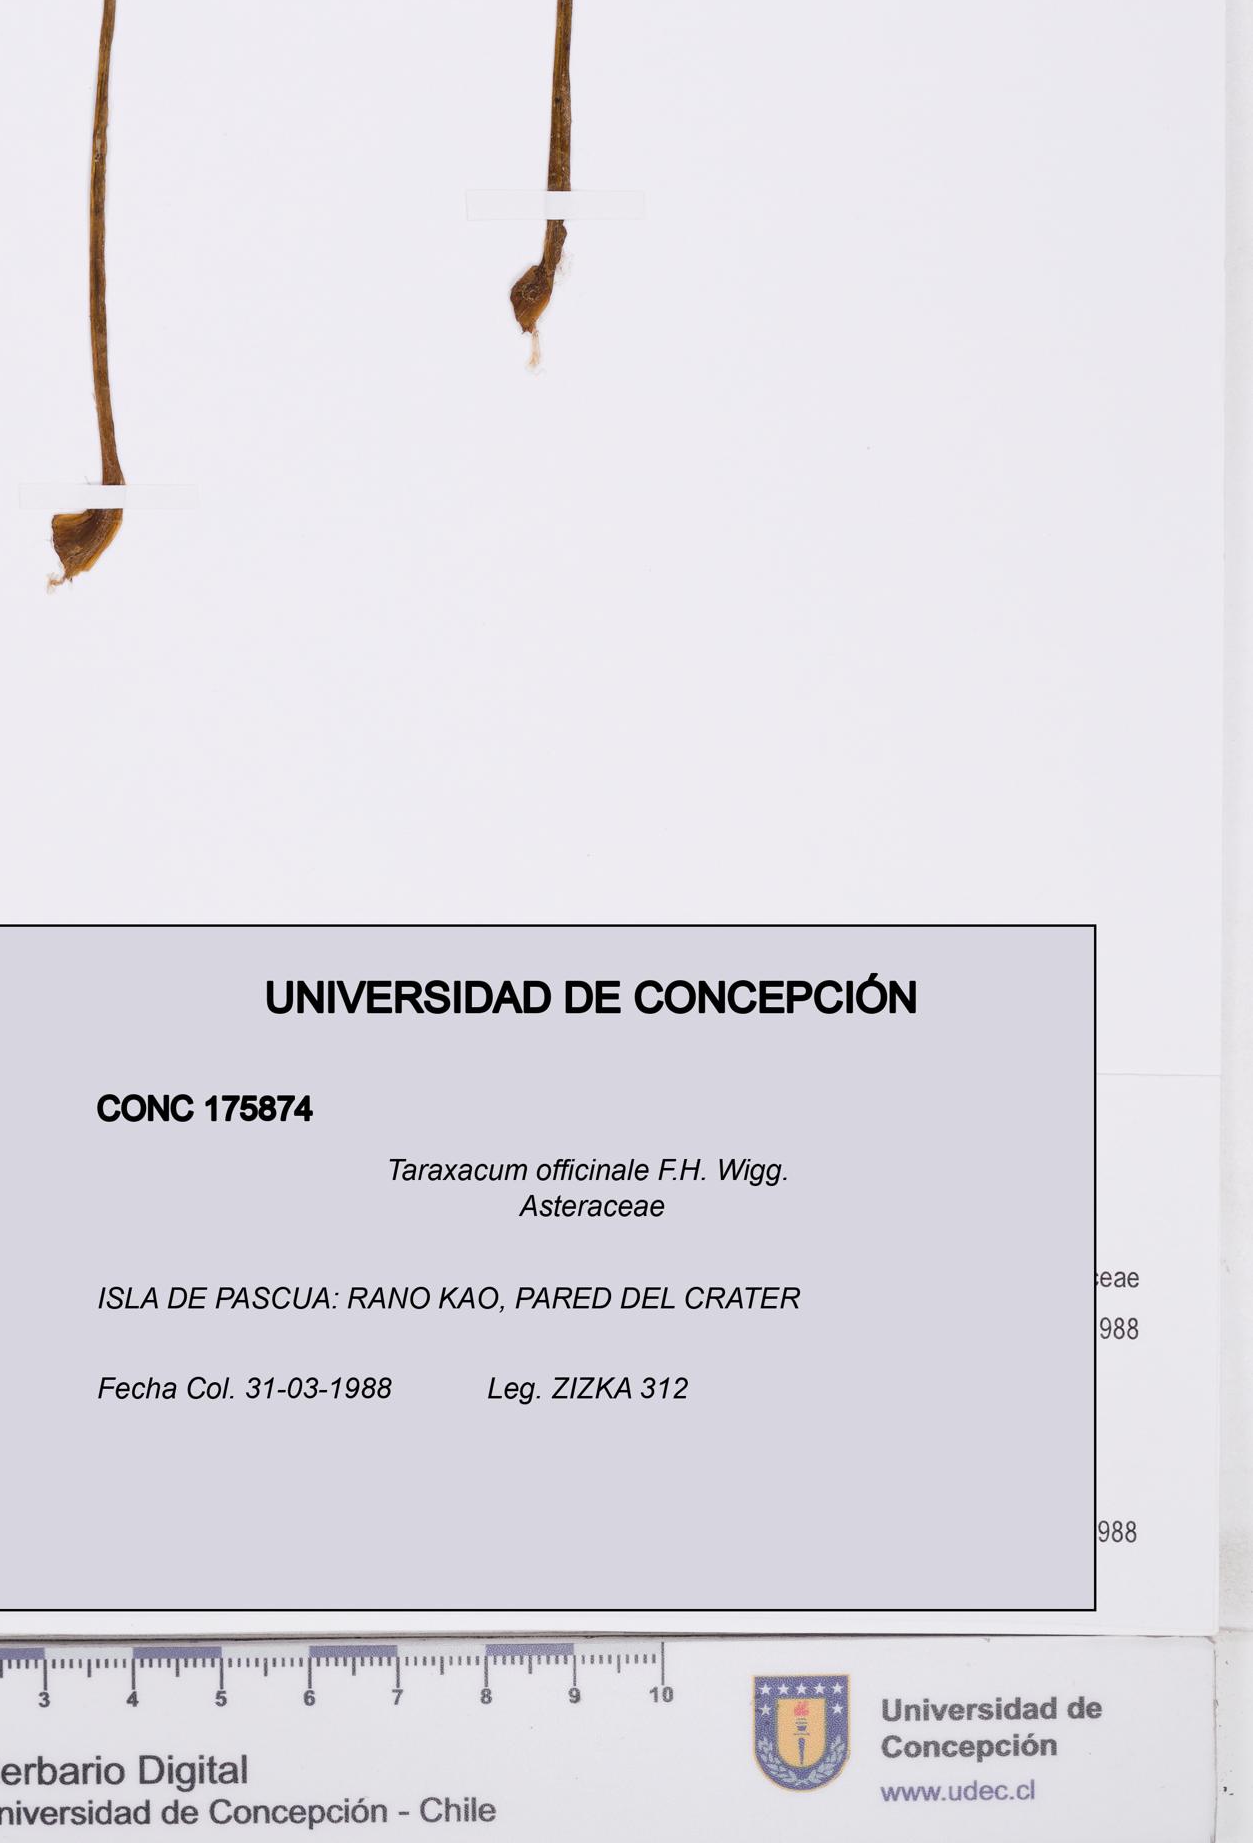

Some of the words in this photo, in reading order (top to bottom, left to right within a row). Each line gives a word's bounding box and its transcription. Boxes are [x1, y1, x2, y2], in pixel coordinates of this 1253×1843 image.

[39, 1691, 51, 1708] 3
[126, 1691, 139, 1707] 4
[215, 1691, 227, 1707] 5
[303, 1690, 316, 1706] 6
[392, 1689, 404, 1705] 7
[480, 1688, 492, 1704] 8
[568, 1688, 581, 1704] 9
[649, 1687, 674, 1703] 10
[881, 1697, 1057, 1722] Universidad
[1067, 1696, 1103, 1720] de
[881, 1733, 1058, 1763] Concepción
[138, 1754, 248, 1793] Digital
[880, 1779, 1036, 1802] www.udec.cl
[160, 1799, 199, 1826] de
[208, 1798, 388, 1831] Concepción
[419, 1796, 497, 1824] Chile
